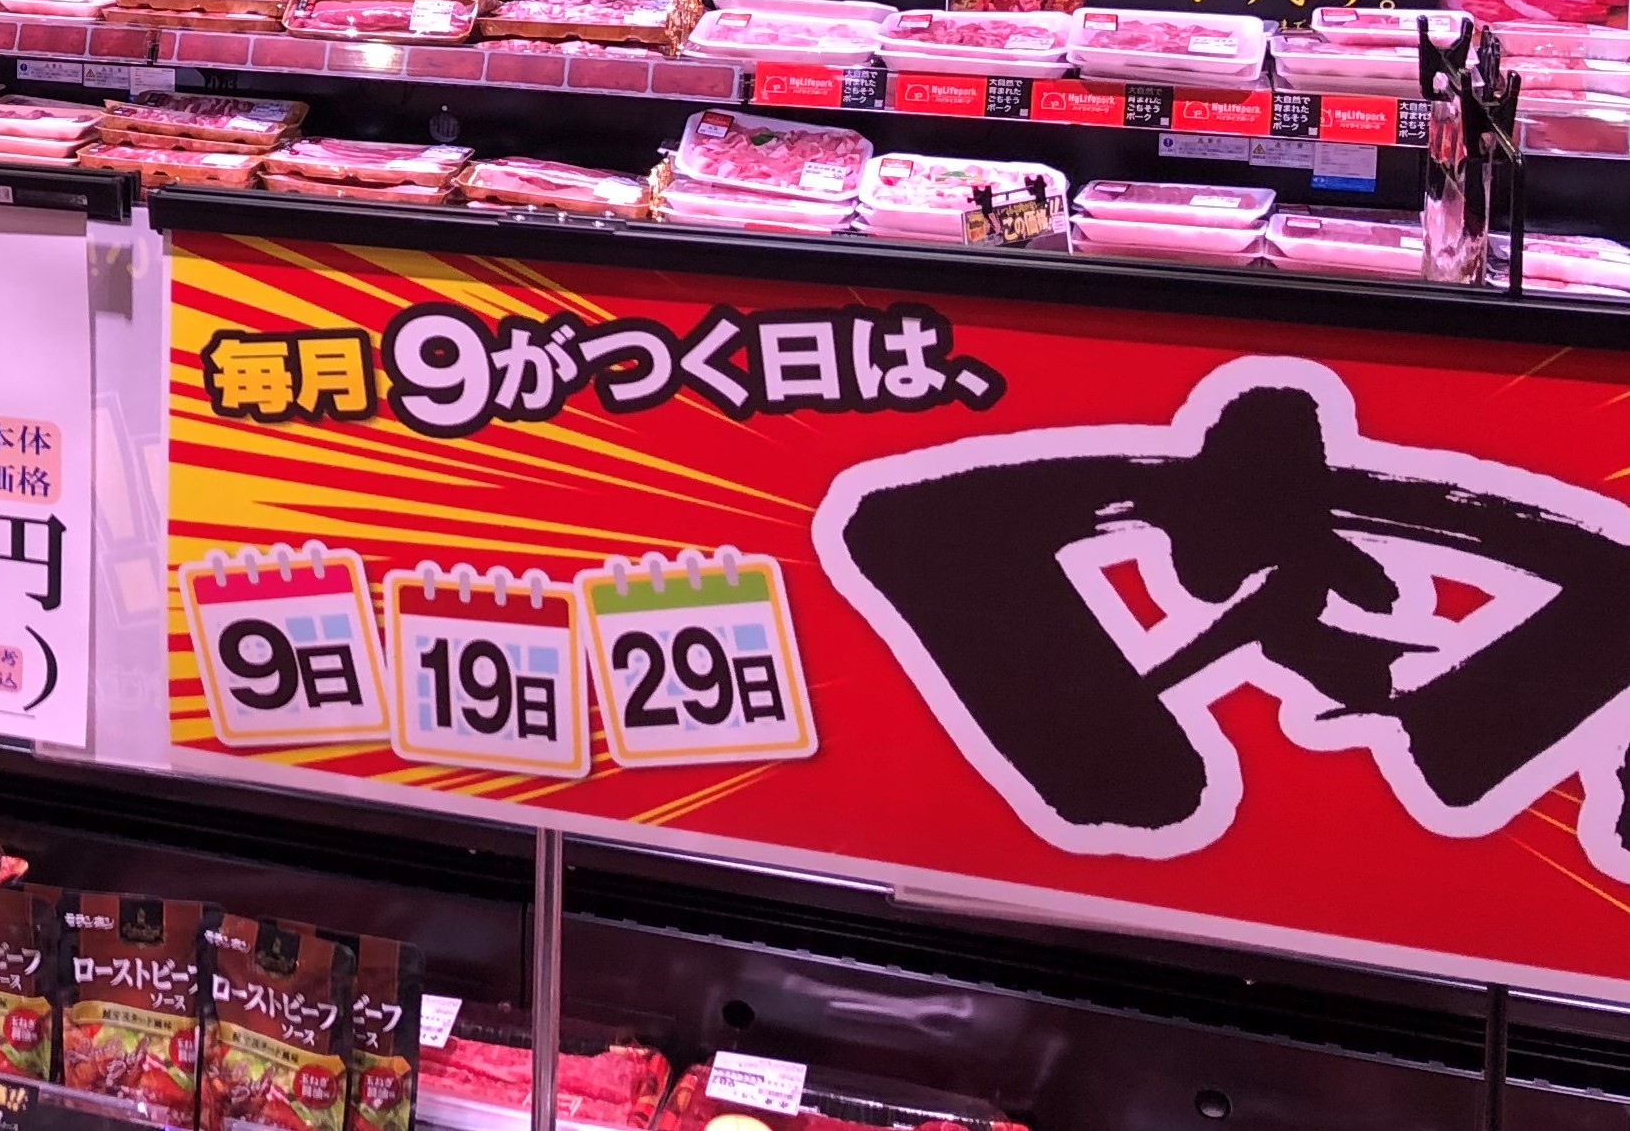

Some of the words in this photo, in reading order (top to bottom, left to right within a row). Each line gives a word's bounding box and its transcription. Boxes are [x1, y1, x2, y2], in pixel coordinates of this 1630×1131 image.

[206, 307, 1000, 434] 毎月9がつく日は、
[825, 369, 1630, 847] 肉
[217, 619, 364, 713] 9日
[419, 637, 558, 742] 19日
[610, 625, 786, 727] 29日
[150, 993, 186, 1010] ソース
[212, 974, 338, 1030] ローストビーフ
[281, 1024, 315, 1046] ソース
